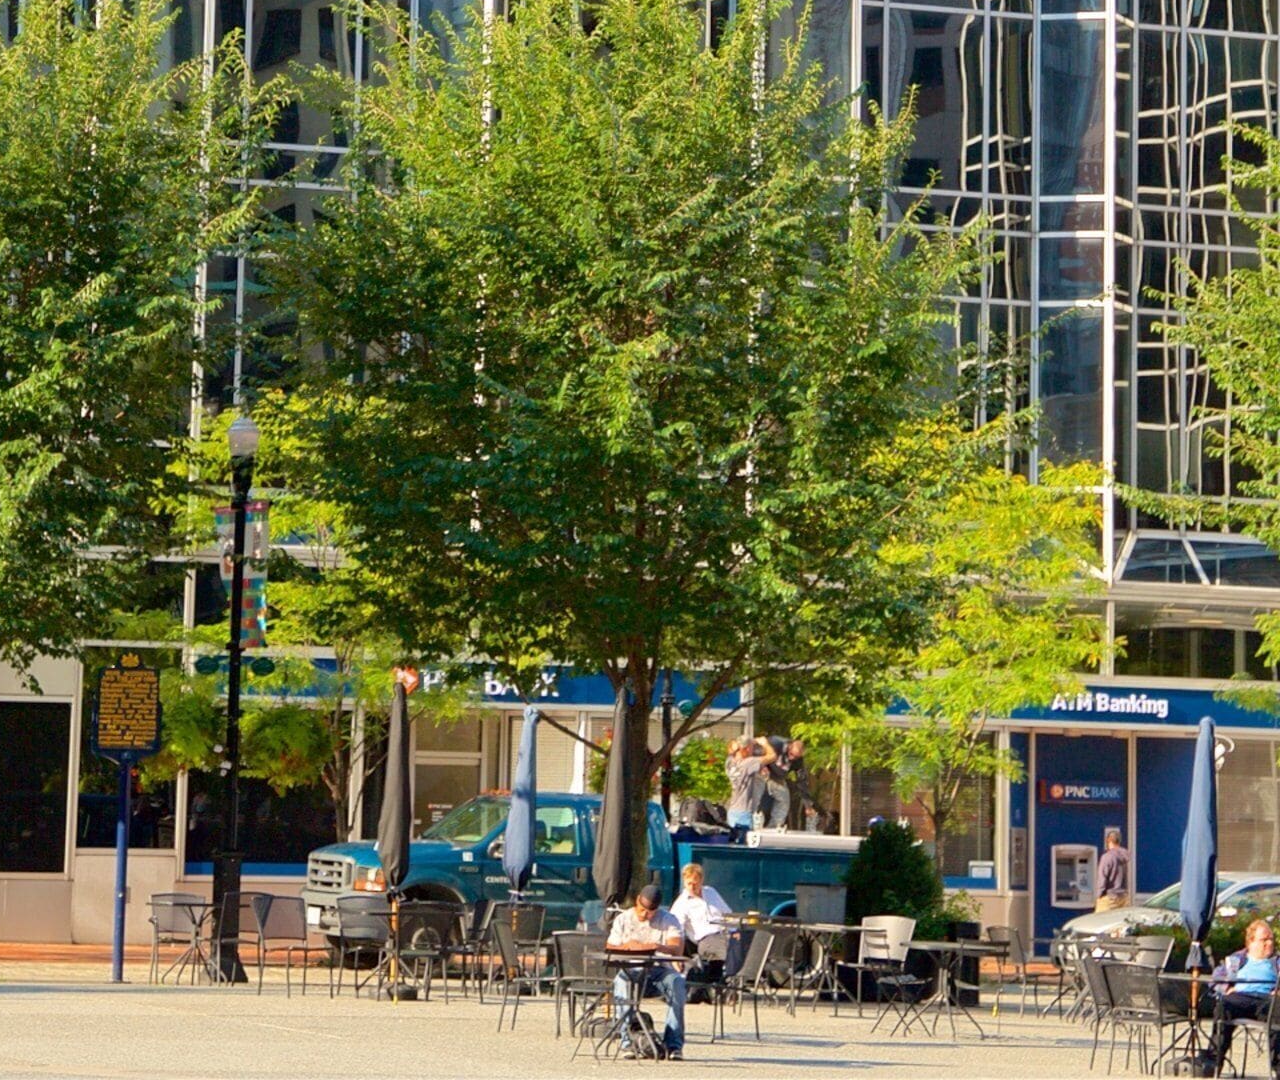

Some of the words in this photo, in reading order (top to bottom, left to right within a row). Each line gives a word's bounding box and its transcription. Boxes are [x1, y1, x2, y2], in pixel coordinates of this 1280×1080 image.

[484, 671, 560, 698] BAK
[1051, 692, 1093, 711] ATM
[1095, 692, 1169, 718] Banking
[1064, 785, 1090, 798] PNC
[1091, 786, 1120, 799] BANK
